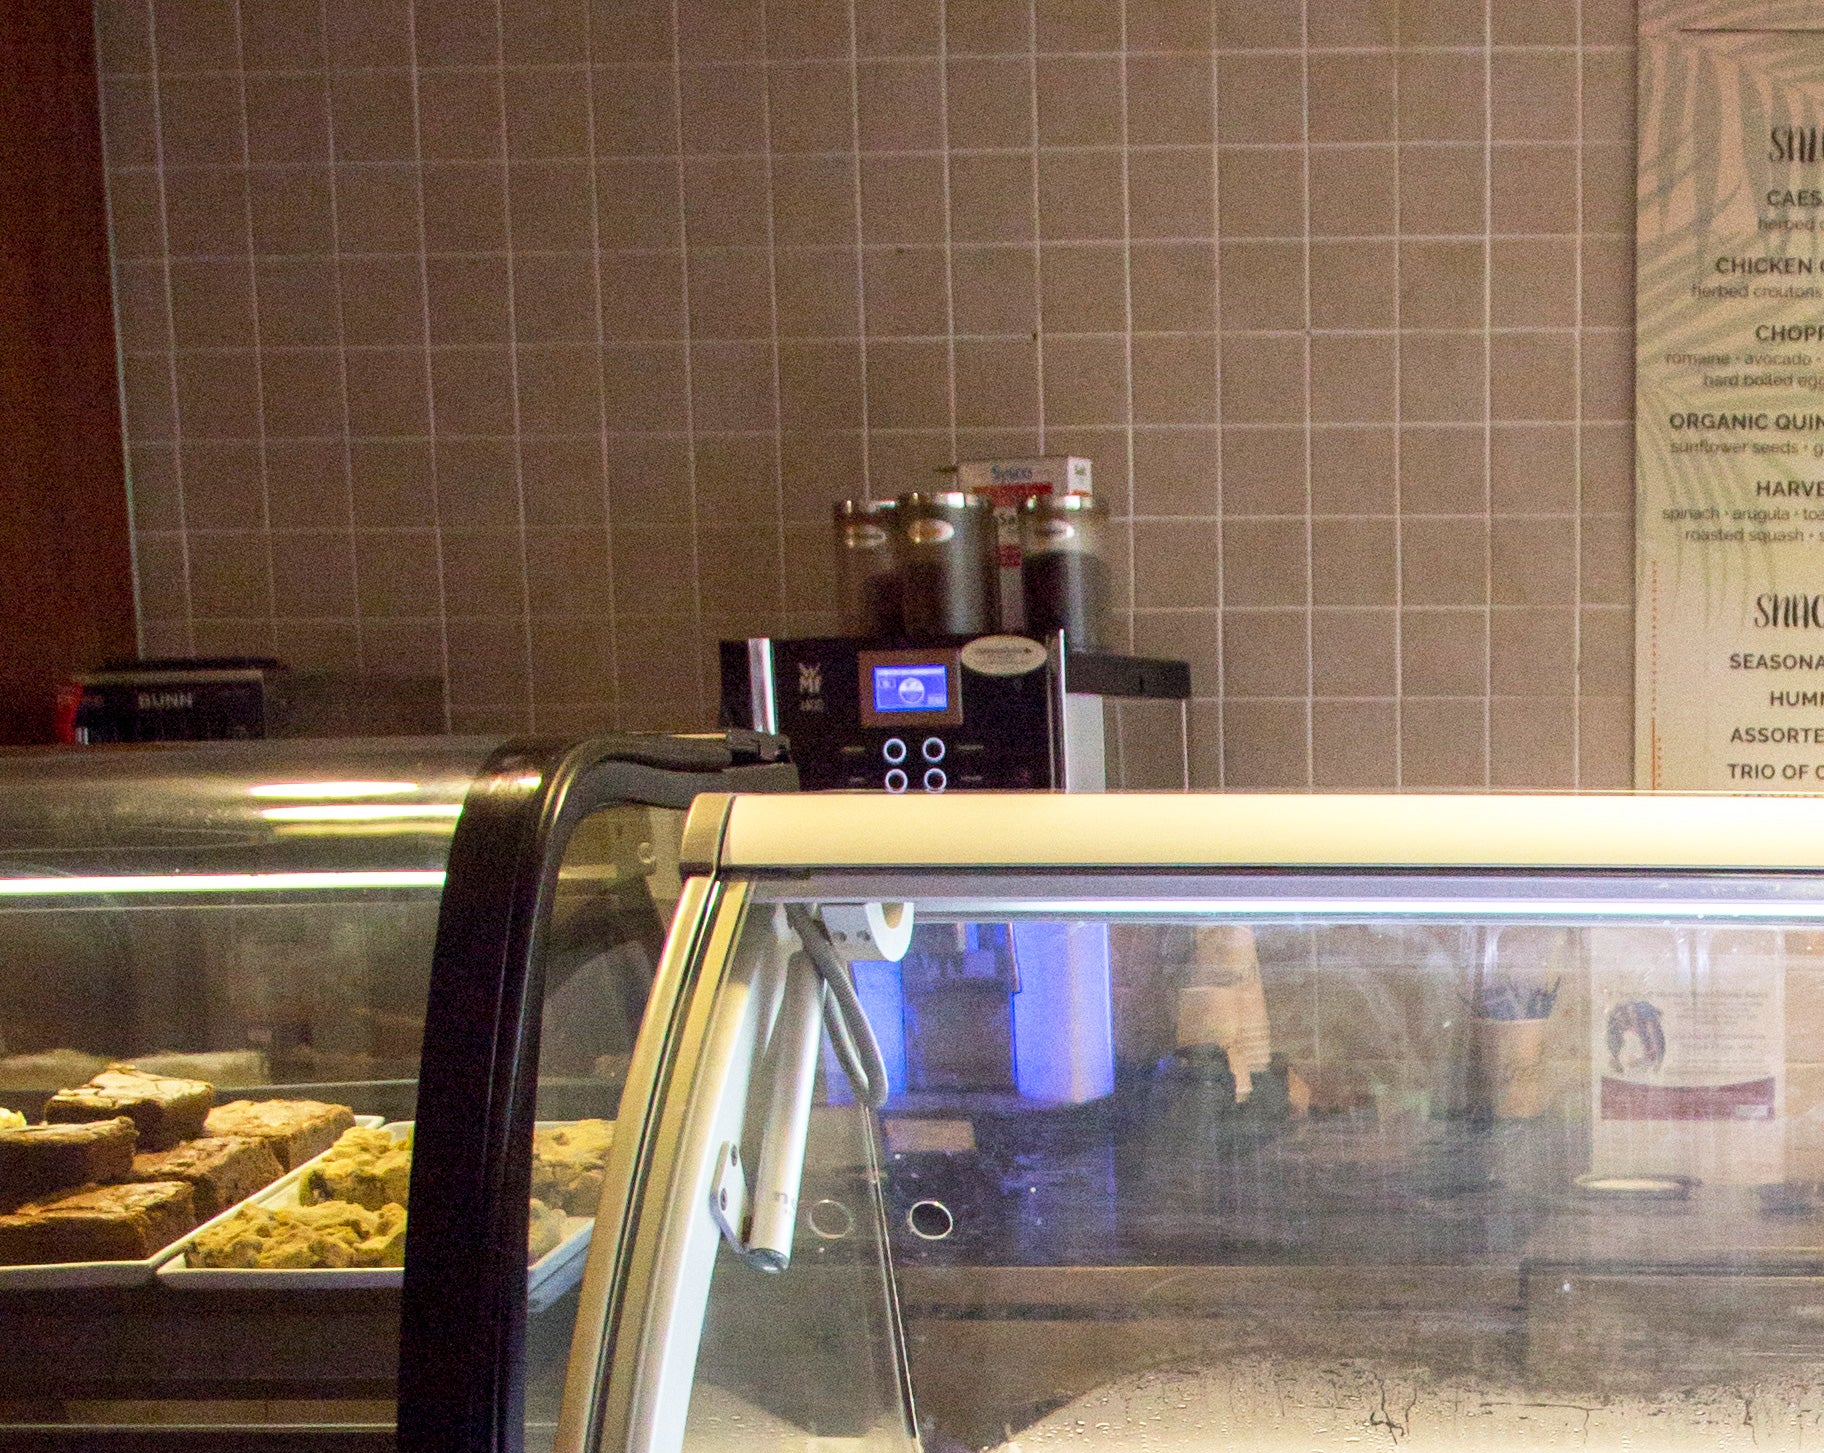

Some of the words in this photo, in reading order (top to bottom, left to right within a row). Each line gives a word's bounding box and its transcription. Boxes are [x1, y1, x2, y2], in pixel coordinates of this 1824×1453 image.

[1715, 258, 1813, 275] CHICKEN
[1669, 413, 1767, 430] ORGANIC
[1728, 763, 1775, 780] TRIO
[1783, 765, 1807, 781] OF
